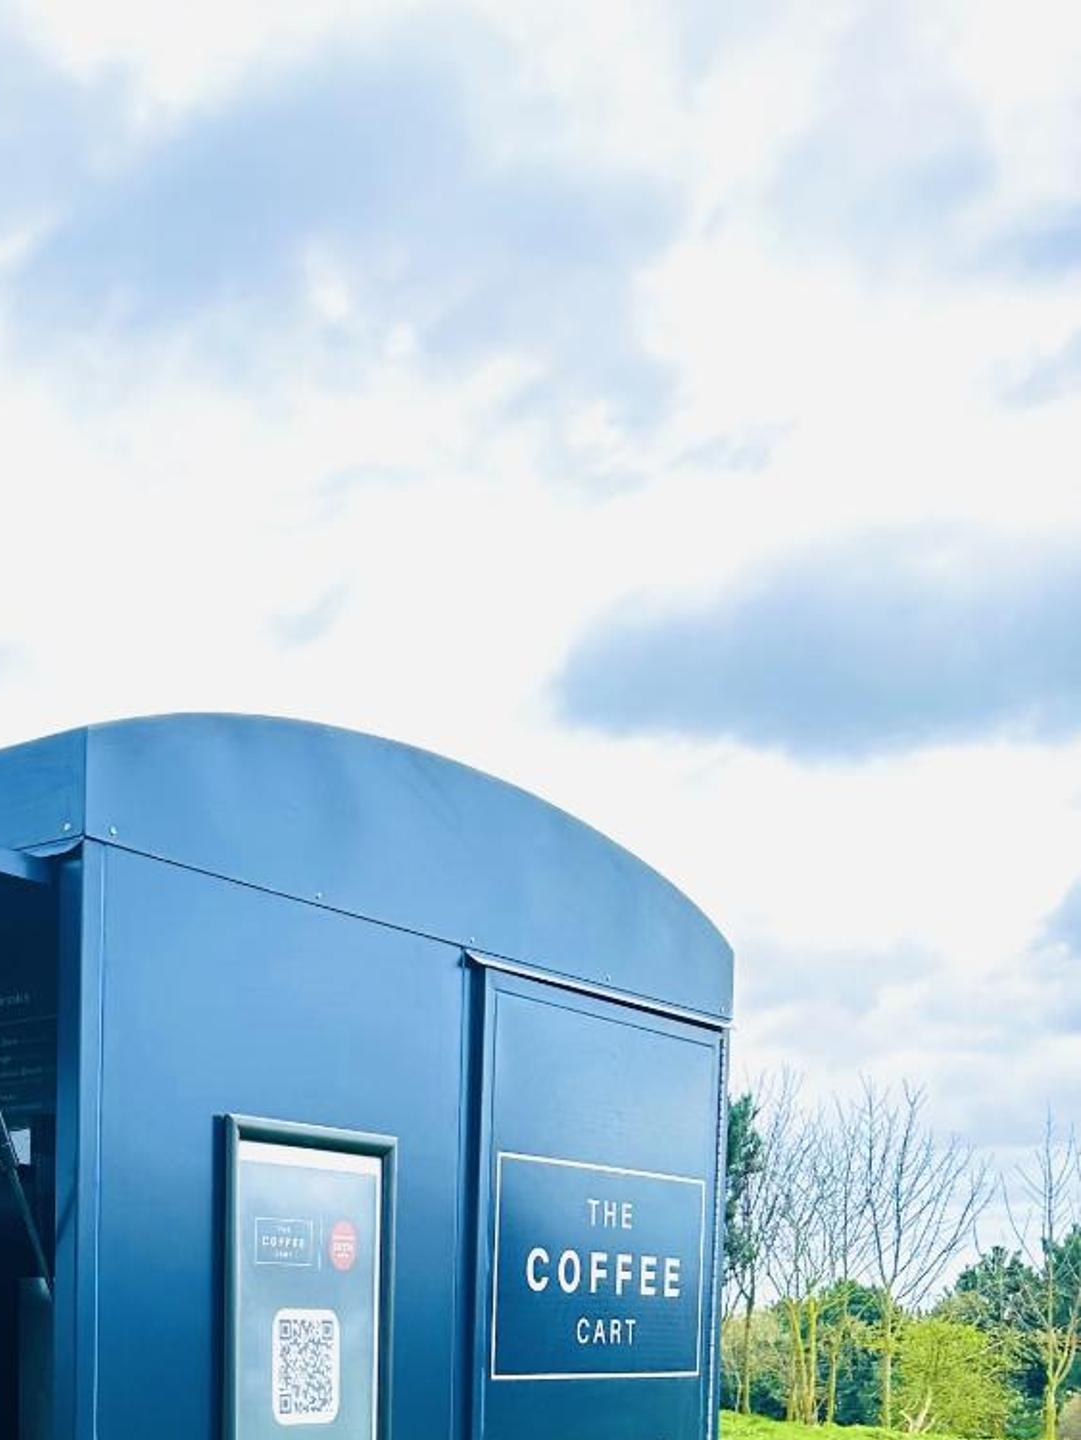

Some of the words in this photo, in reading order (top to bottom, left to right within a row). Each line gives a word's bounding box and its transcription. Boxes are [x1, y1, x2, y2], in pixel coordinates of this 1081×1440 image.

[587, 1198, 633, 1230] THE
[526, 1247, 681, 1297] COFFEE
[576, 1317, 637, 1345] CART
